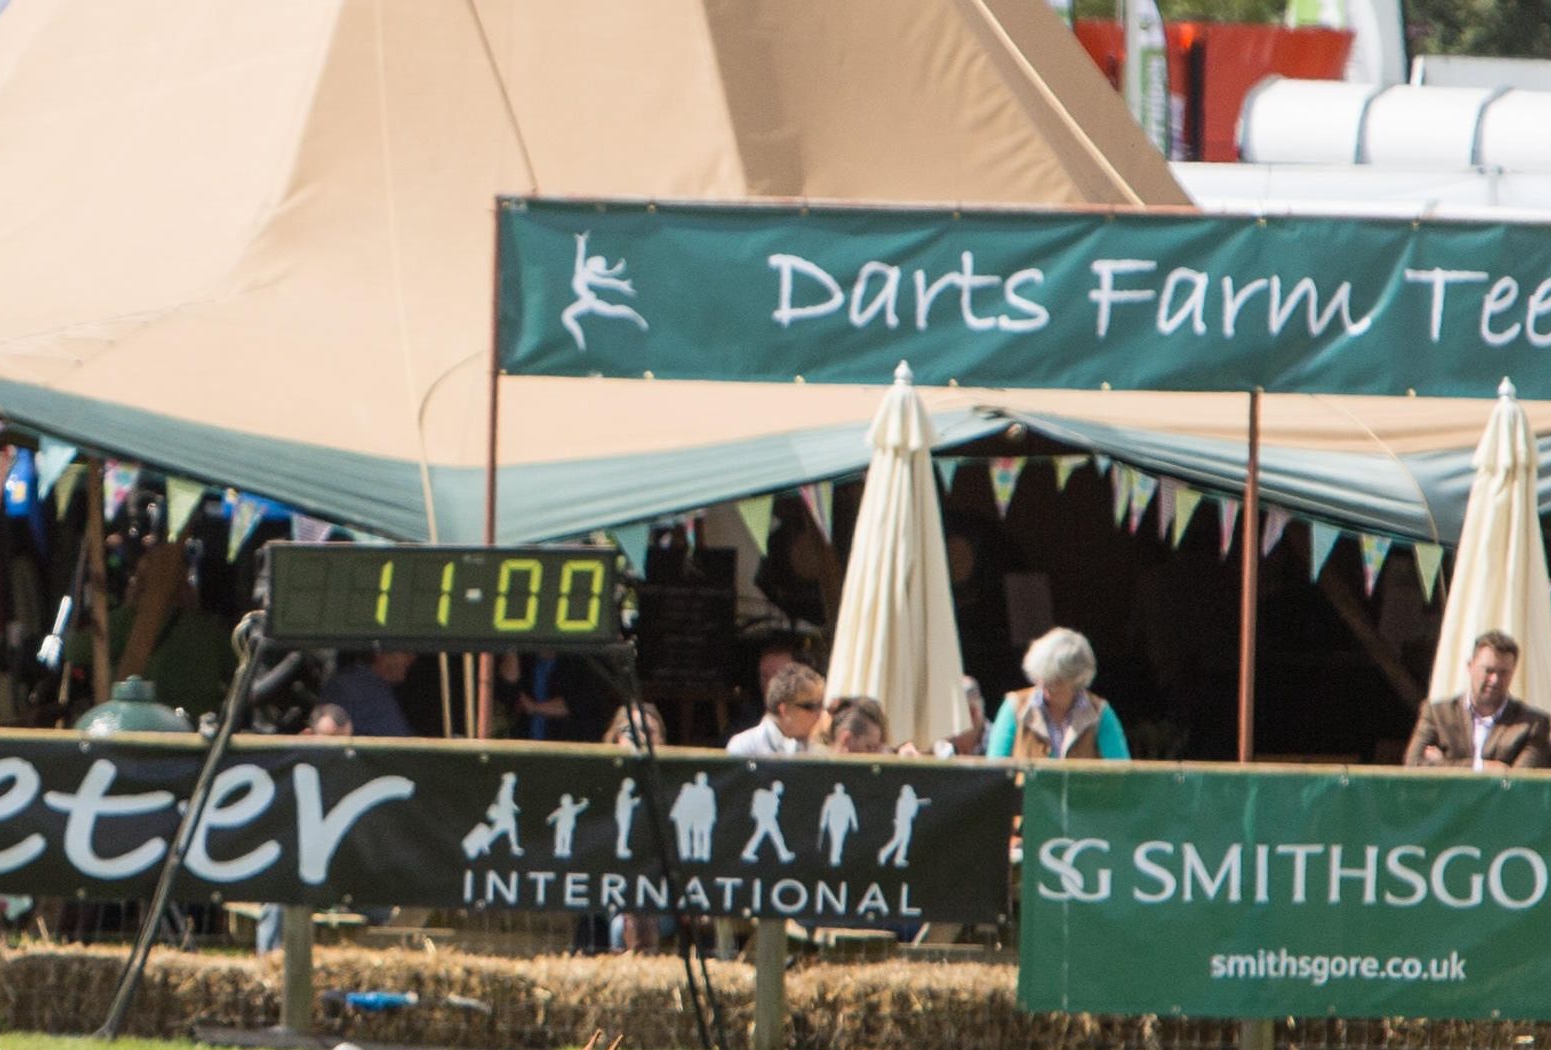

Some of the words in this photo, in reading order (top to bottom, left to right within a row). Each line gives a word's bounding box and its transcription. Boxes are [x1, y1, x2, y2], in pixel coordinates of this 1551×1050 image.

[767, 250, 1051, 333] Darts
[1088, 258, 1372, 338] Farm
[463, 868, 923, 918] INTERNATIONAL
[1211, 948, 1466, 986] smithsgore.co.uk
